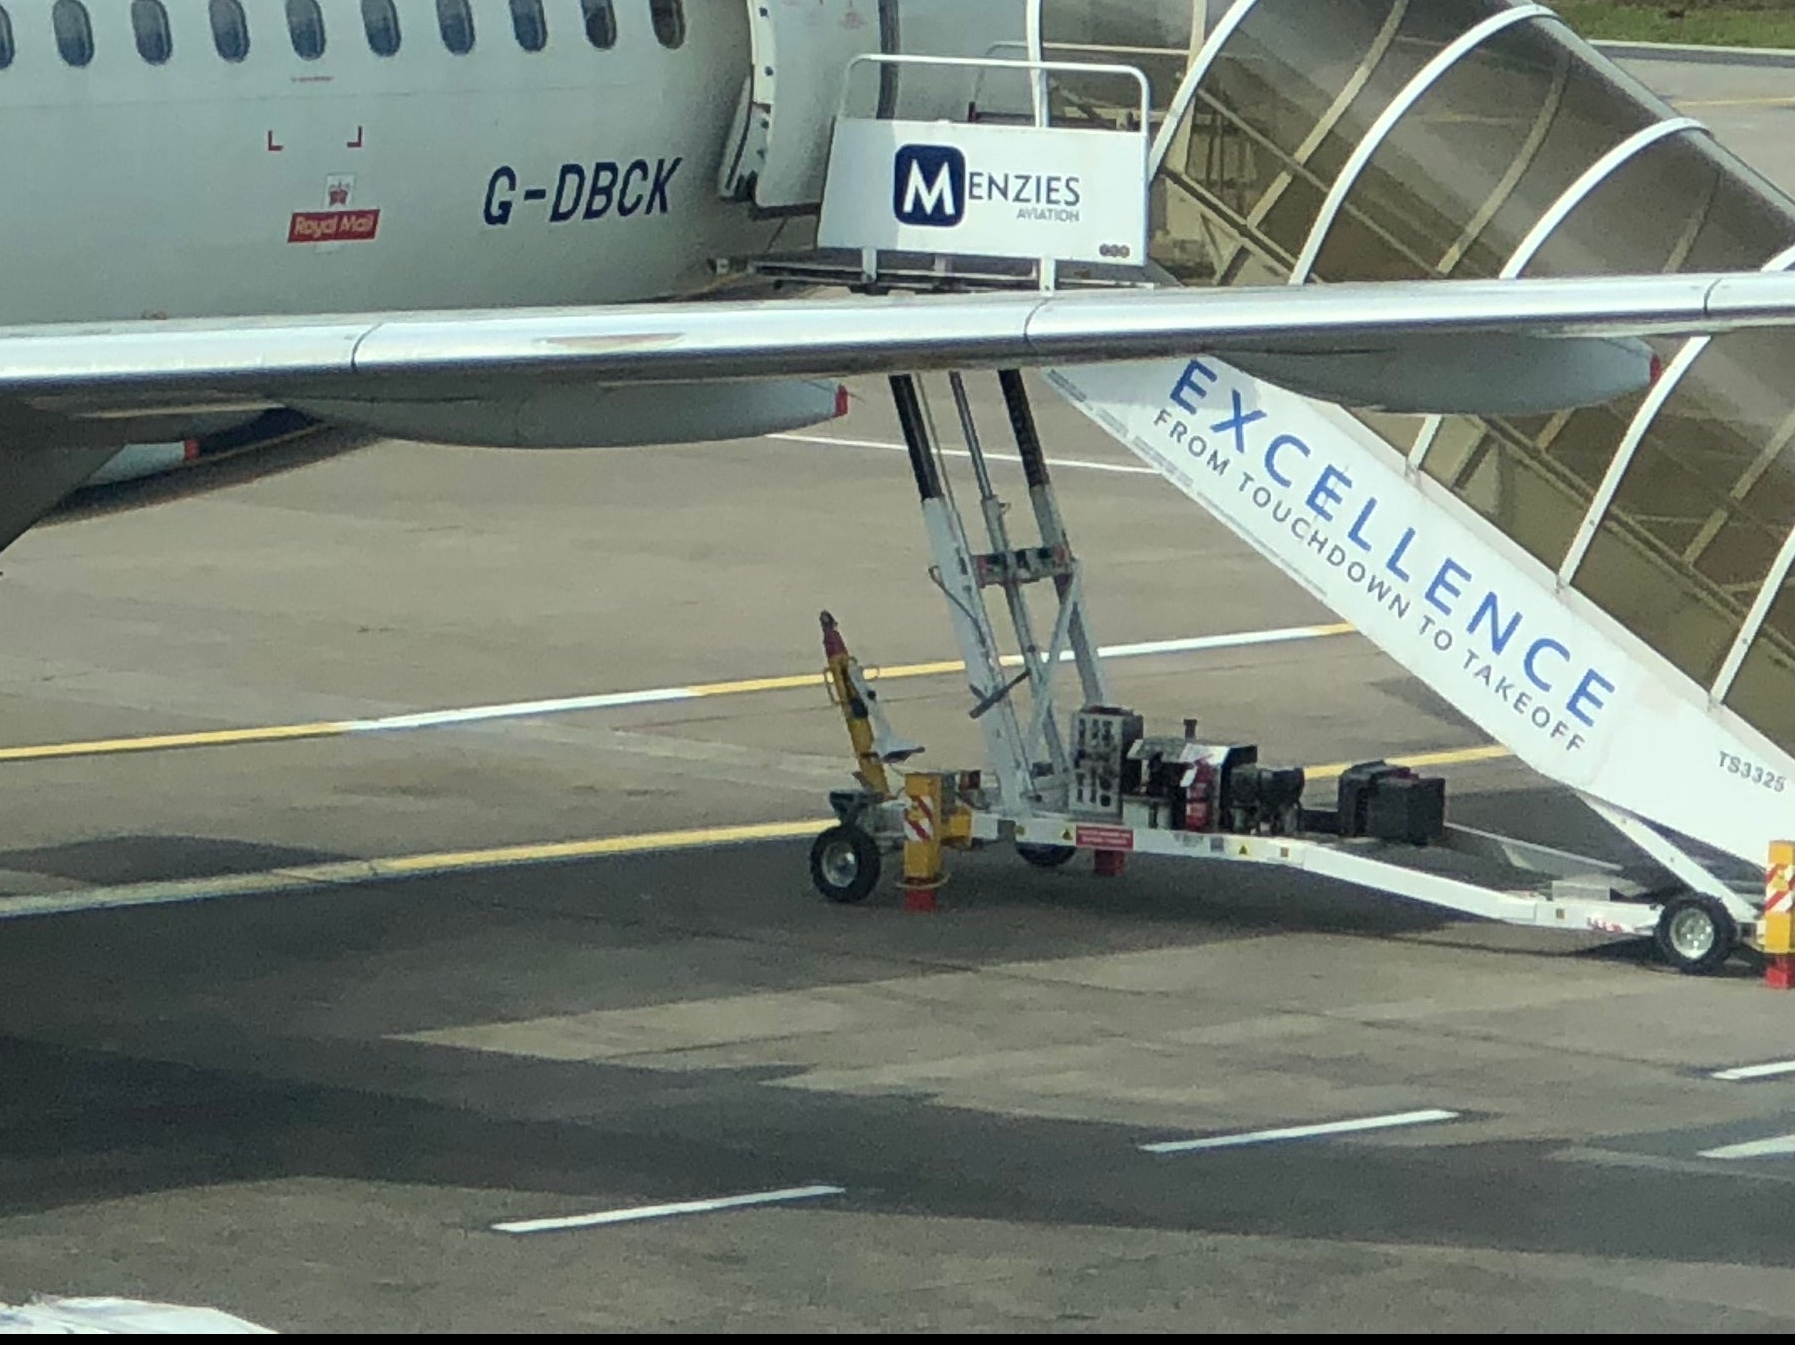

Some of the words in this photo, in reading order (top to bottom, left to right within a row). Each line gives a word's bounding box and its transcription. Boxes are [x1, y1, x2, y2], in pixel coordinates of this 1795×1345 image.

[483, 157, 683, 225] G-DBCK
[903, 158, 1081, 216] MENZIES
[1016, 208, 1080, 222] AVIATION
[294, 214, 338, 238] Royal
[338, 213, 375, 233] Mail
[1169, 357, 1616, 728] EXCELLENCE
[1153, 408, 1231, 477] FROM
[1238, 471, 1411, 619] TOUCHDOWN
[1418, 614, 1453, 651] TO
[1462, 648, 1586, 752] TAKEOFF
[1719, 750, 1787, 793] TS3325
